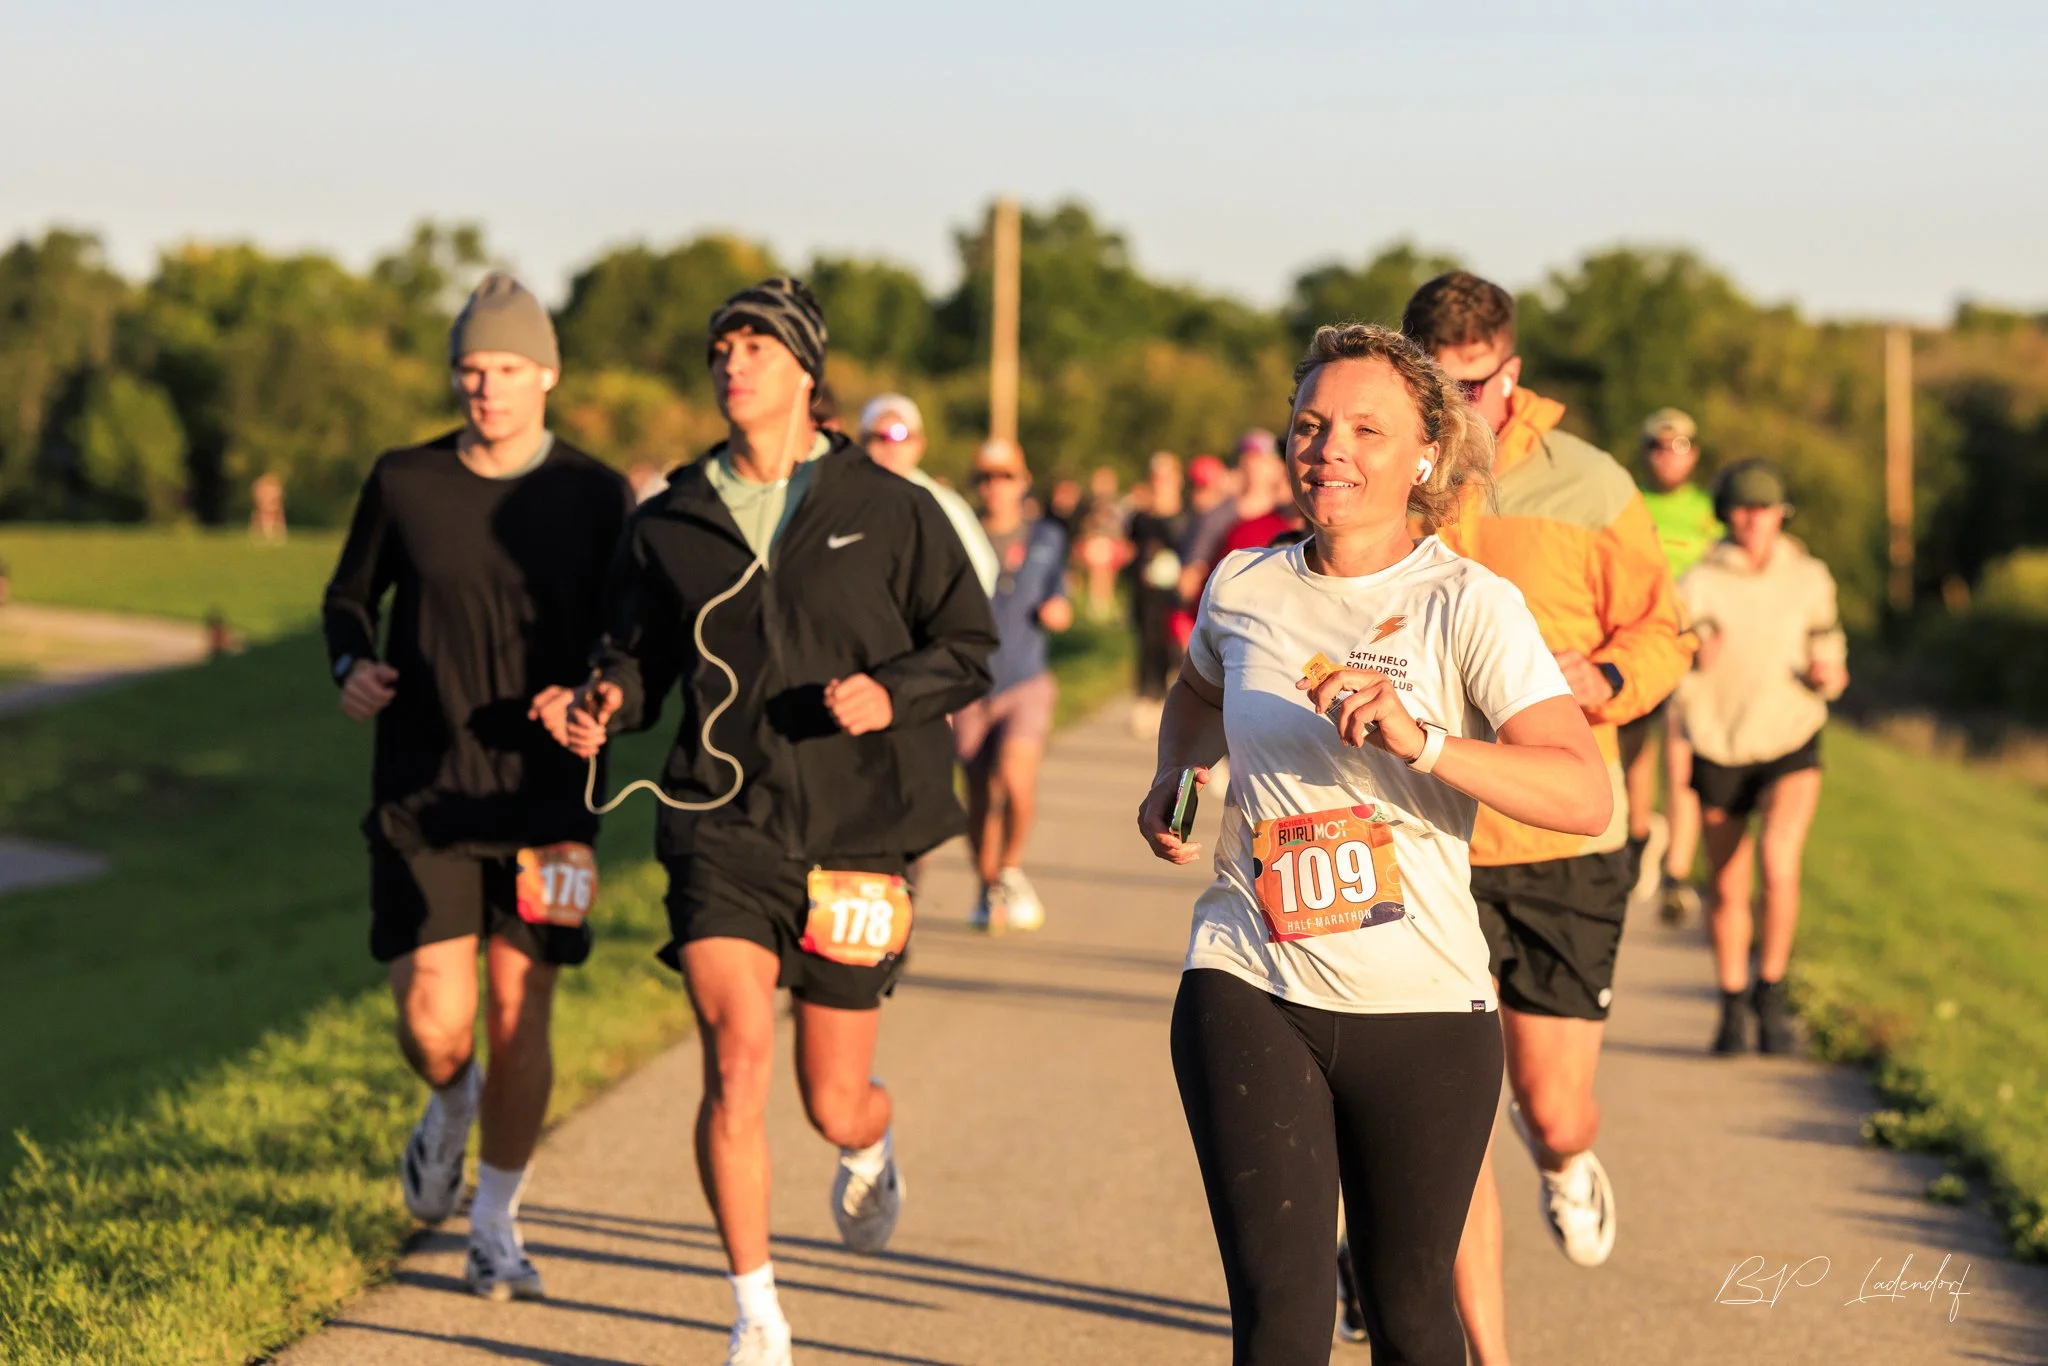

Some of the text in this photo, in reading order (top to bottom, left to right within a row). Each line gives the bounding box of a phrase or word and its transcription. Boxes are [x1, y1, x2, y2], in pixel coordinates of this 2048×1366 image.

[1349, 651, 1408, 667] 54TH HELO
[1390, 680, 1413, 692] LUB
[1278, 817, 1313, 829] SCHEELS
[541, 864, 593, 910] 176
[1271, 840, 1377, 914] 109
[830, 897, 894, 948] 178
[1287, 909, 1372, 932] HALF MARATHON
